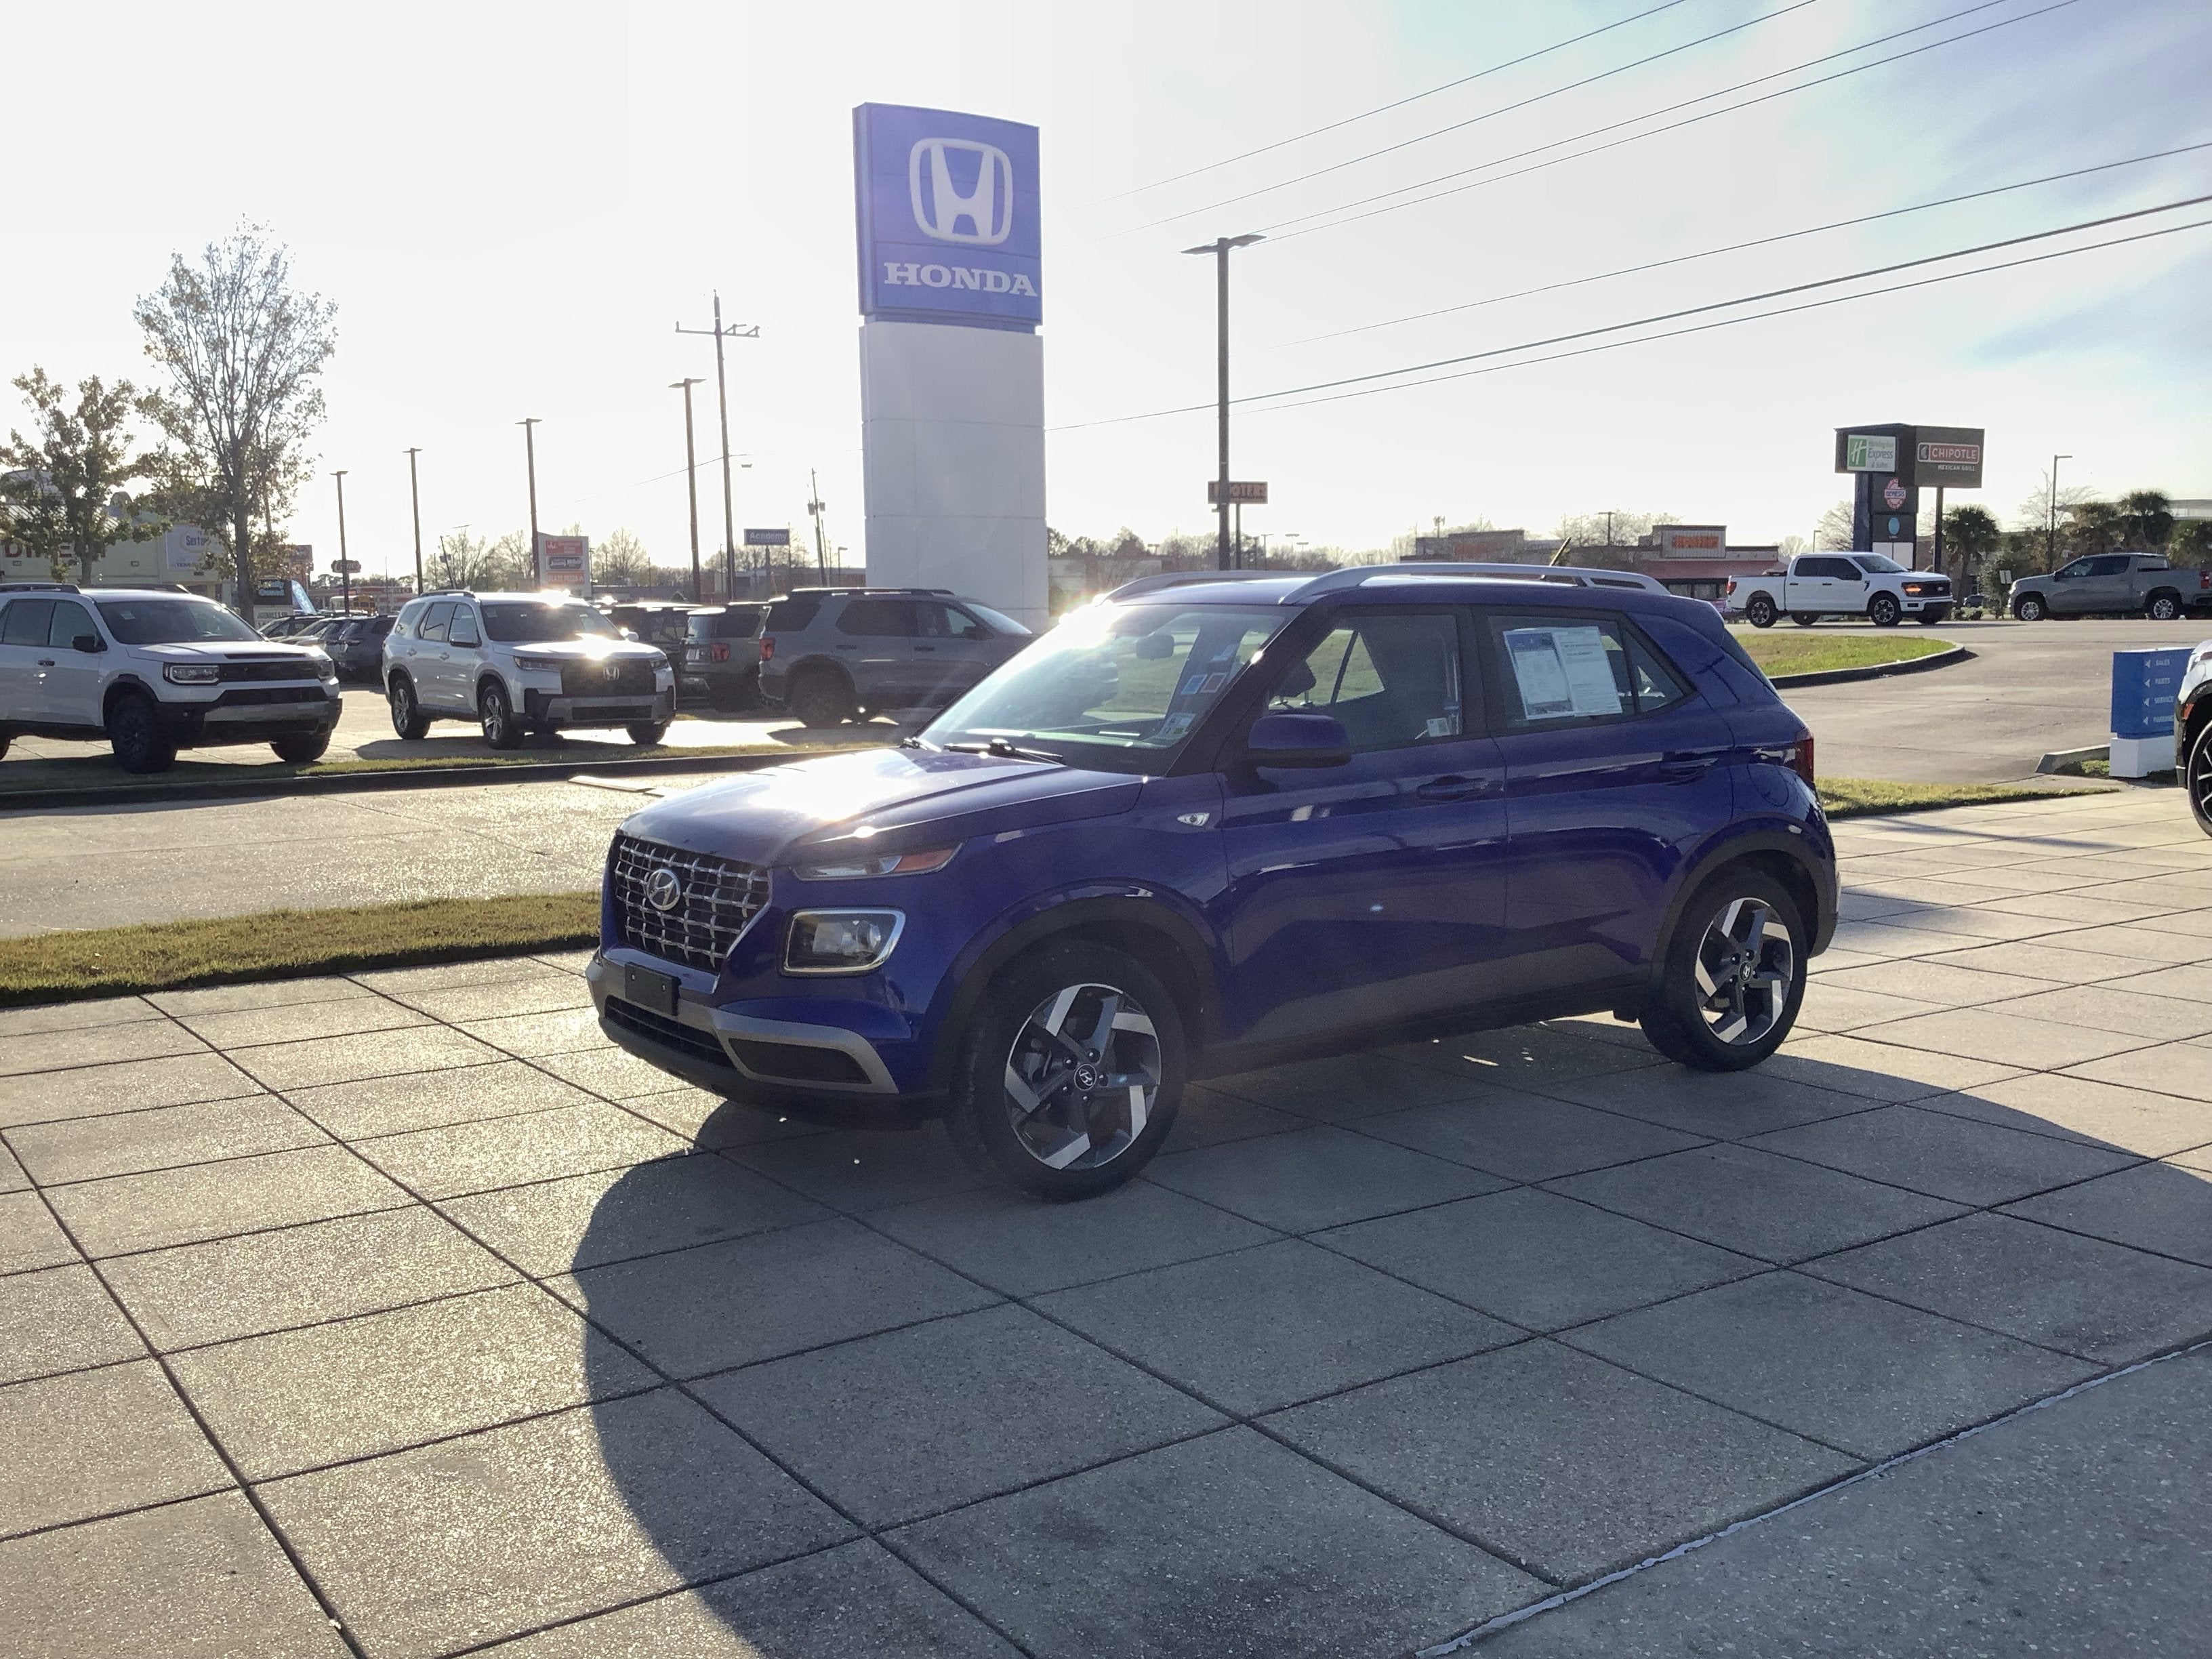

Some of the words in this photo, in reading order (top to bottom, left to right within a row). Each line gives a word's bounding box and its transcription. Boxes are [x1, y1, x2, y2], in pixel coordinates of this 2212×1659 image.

[884, 262, 1038, 297] HONDA
[1868, 447, 1893, 461] Express
[1931, 447, 1978, 459] CHIPOTLE
[750, 531, 787, 541] Academy
